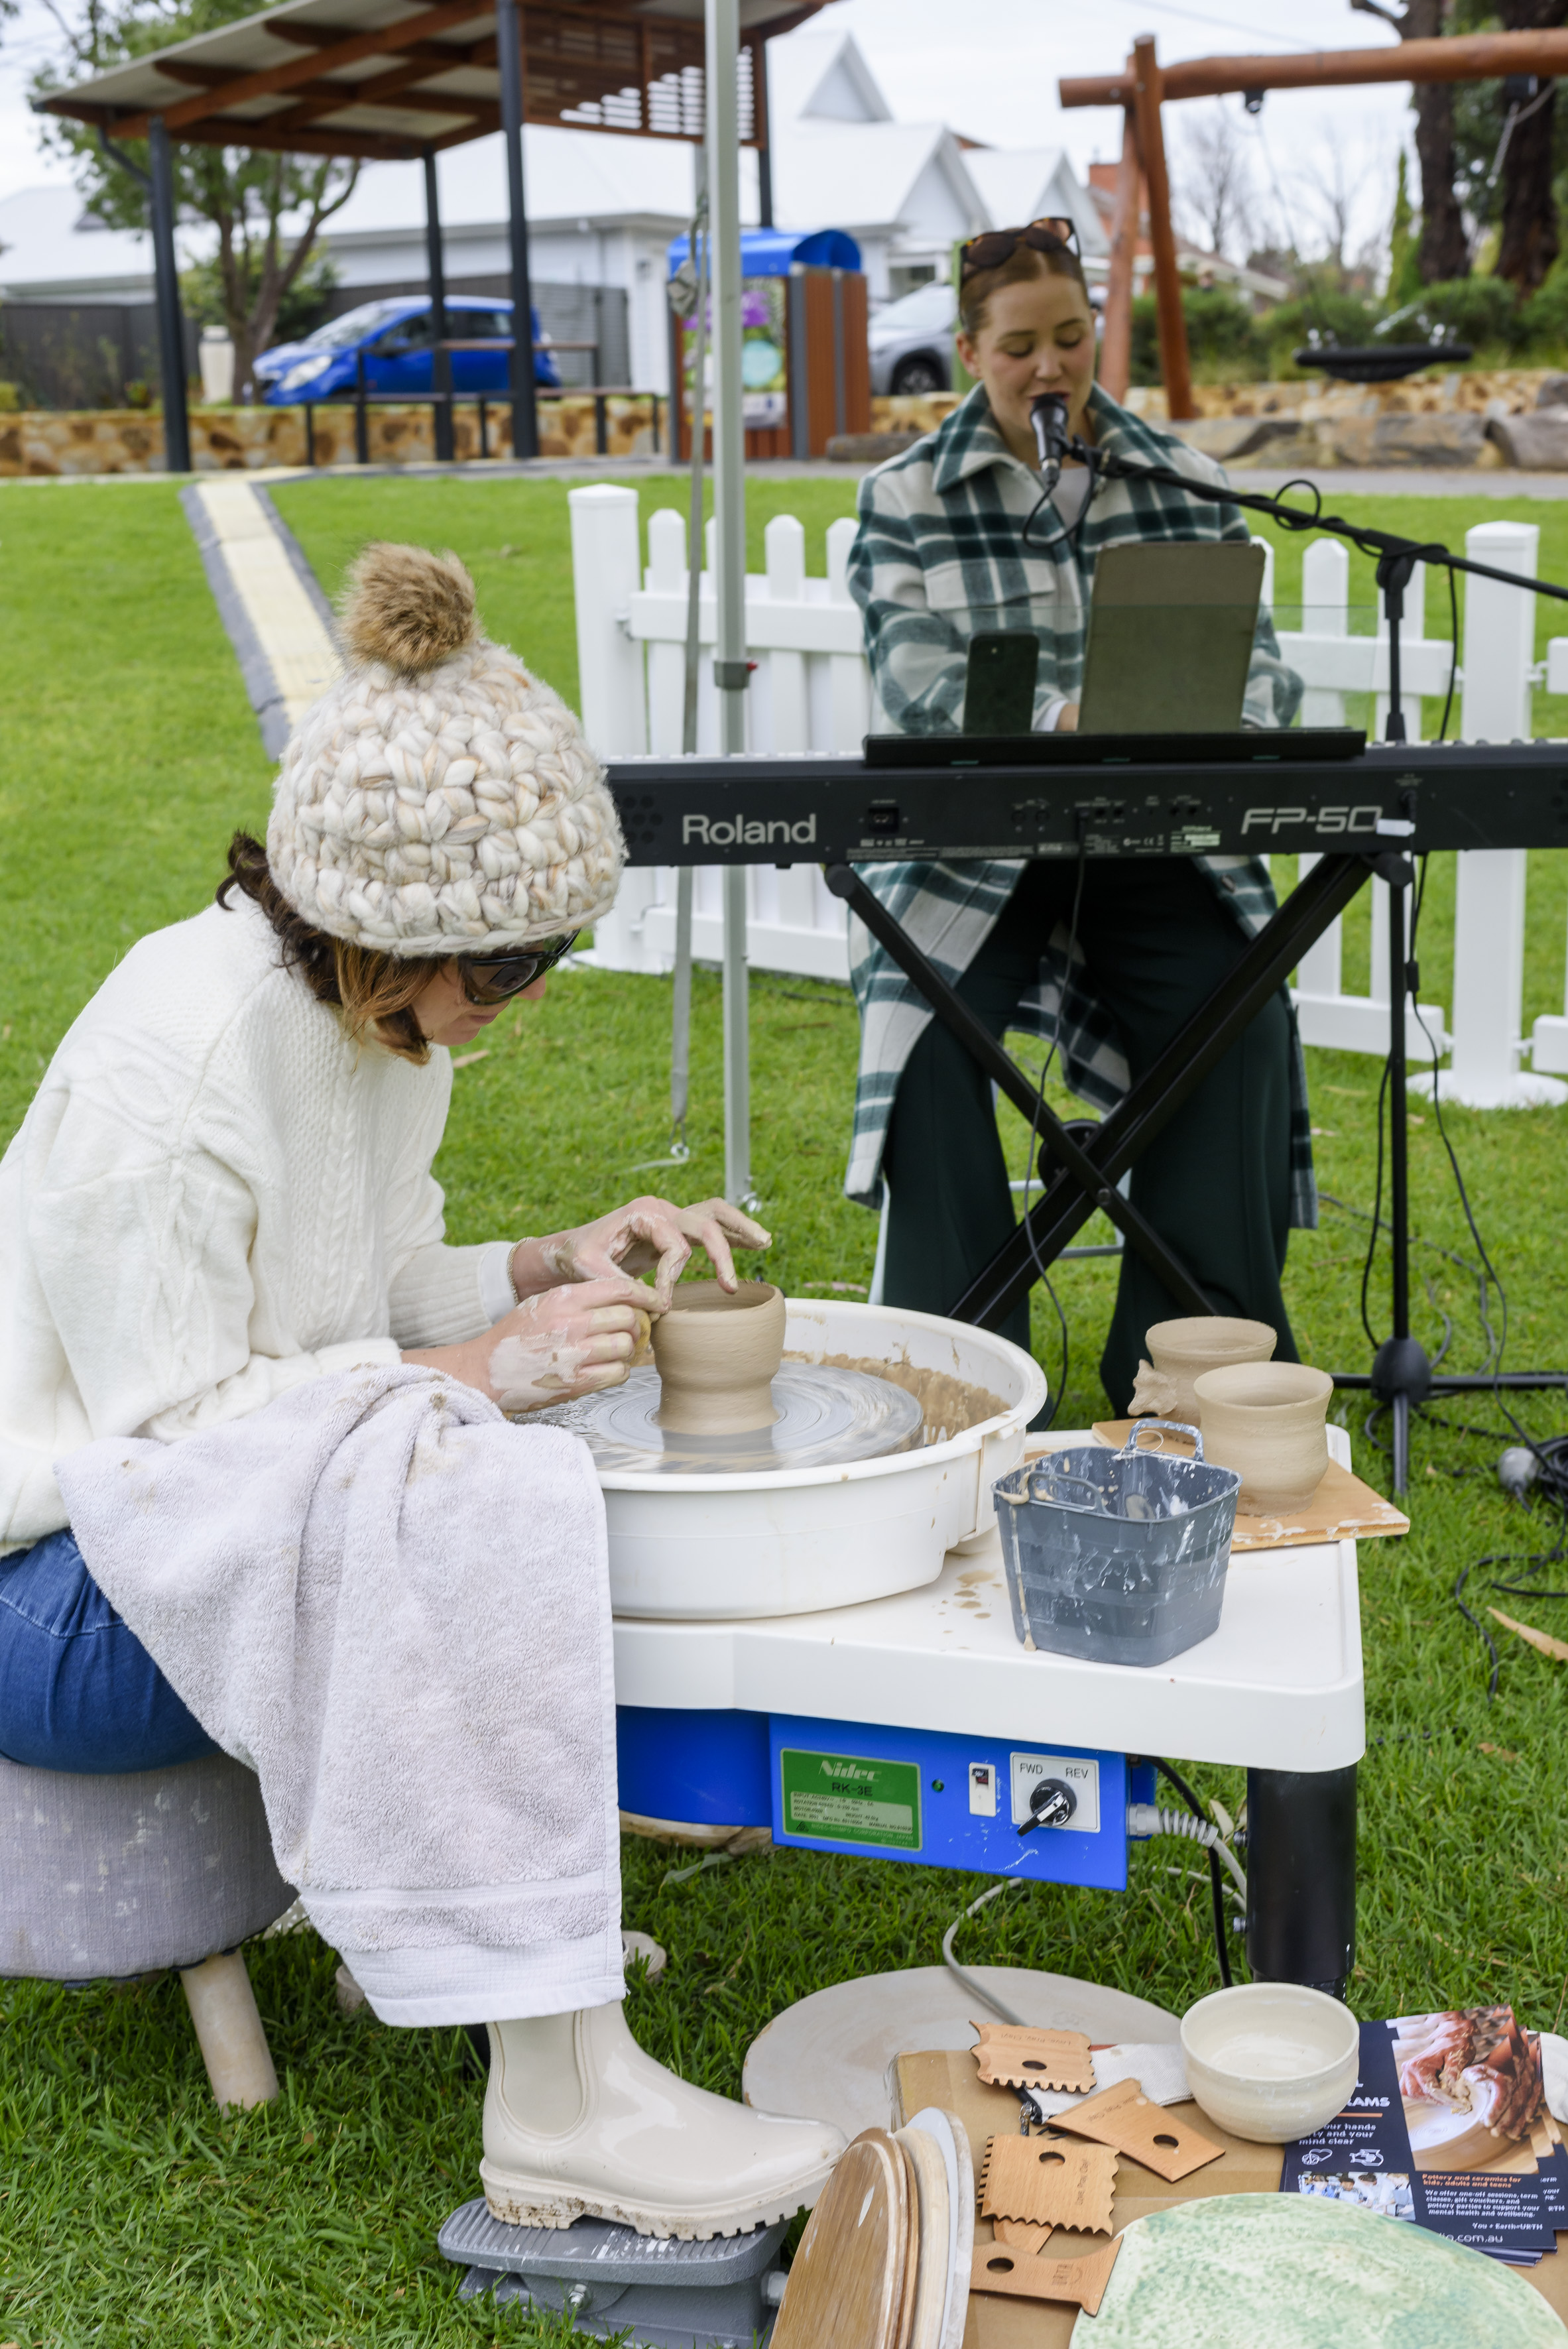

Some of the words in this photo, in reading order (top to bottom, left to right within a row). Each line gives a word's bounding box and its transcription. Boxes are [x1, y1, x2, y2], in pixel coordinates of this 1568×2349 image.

[1240, 805, 1382, 835] FP-50
[682, 813, 816, 845] Roland
[818, 1760, 882, 1781] Nidec
[1020, 1763, 1044, 1775] FWD
[1065, 1767, 1089, 1779] REV
[831, 1781, 873, 1797] RK-3E
[1347, 2096, 1390, 2107] AMS
[1422, 2173, 1453, 2182] Pottery
